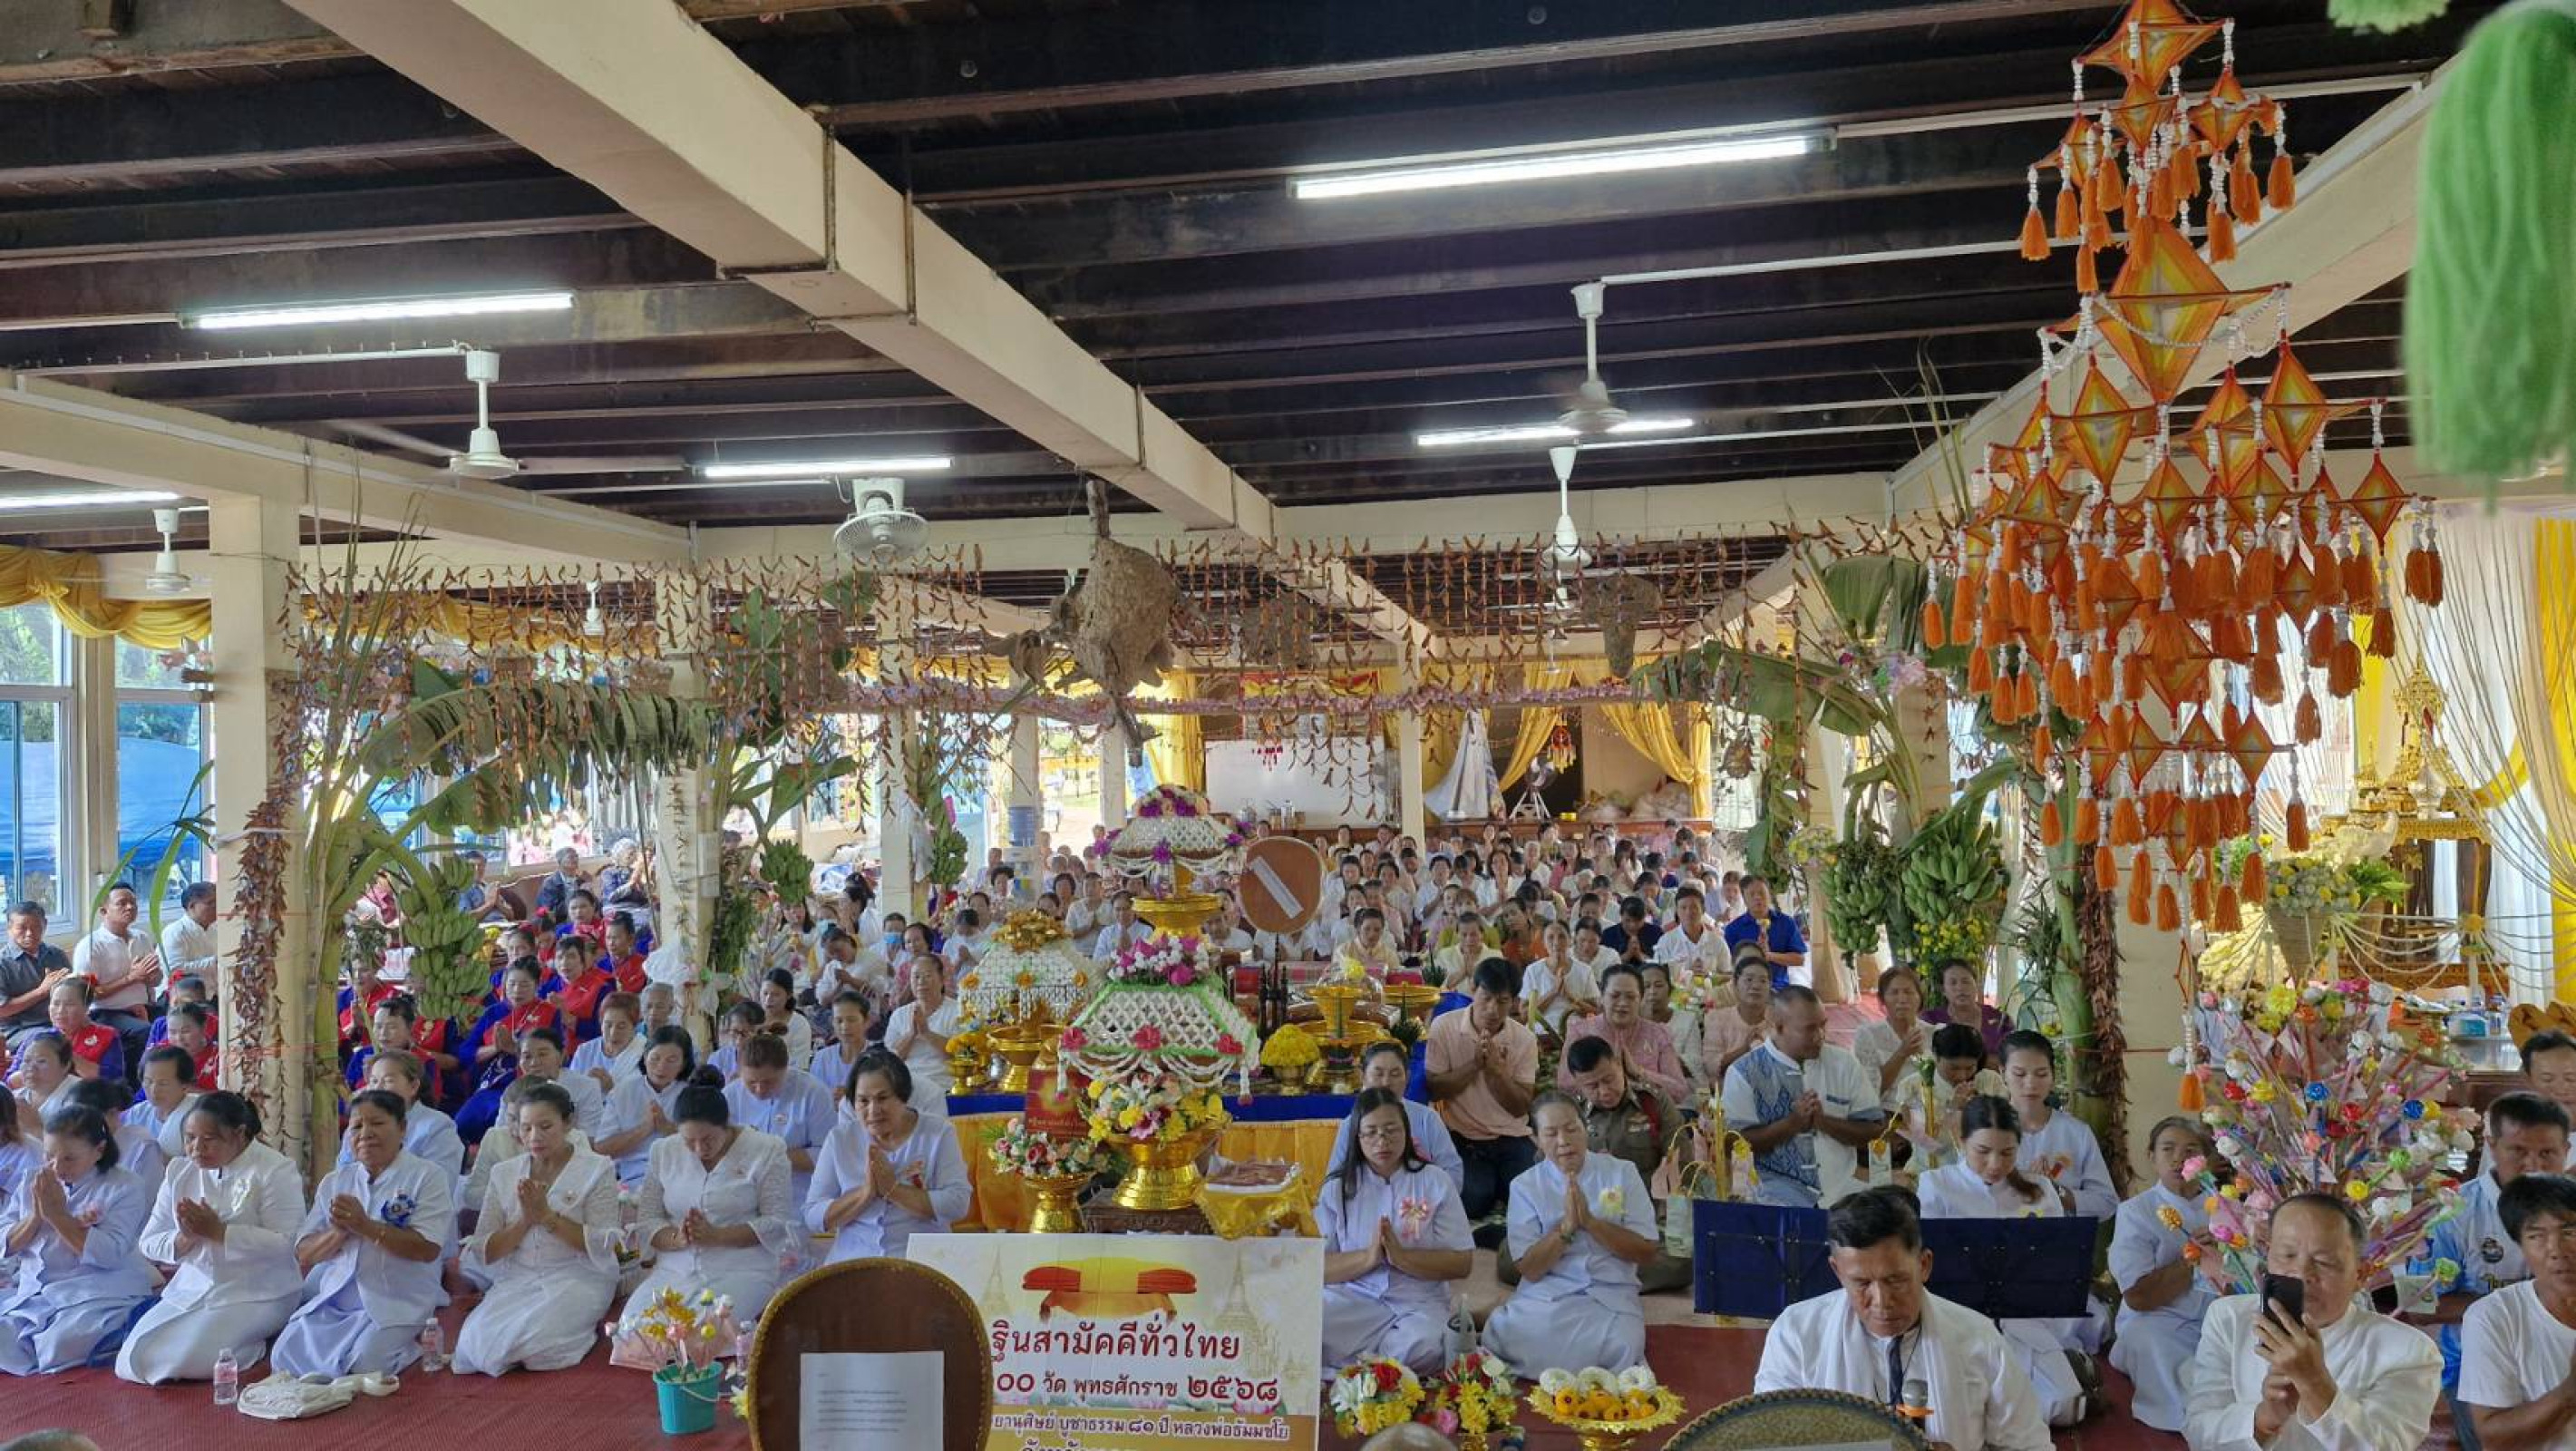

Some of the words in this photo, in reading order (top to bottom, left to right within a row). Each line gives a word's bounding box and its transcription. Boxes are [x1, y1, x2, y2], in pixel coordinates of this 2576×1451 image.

[1043, 1370, 1066, 1393] วัด
[1074, 1373, 1178, 1402] พุทธศักราช
[1188, 1374, 1278, 1402] ๒๕๖๘
[992, 1412, 1055, 1435] ยานุศิษย์
